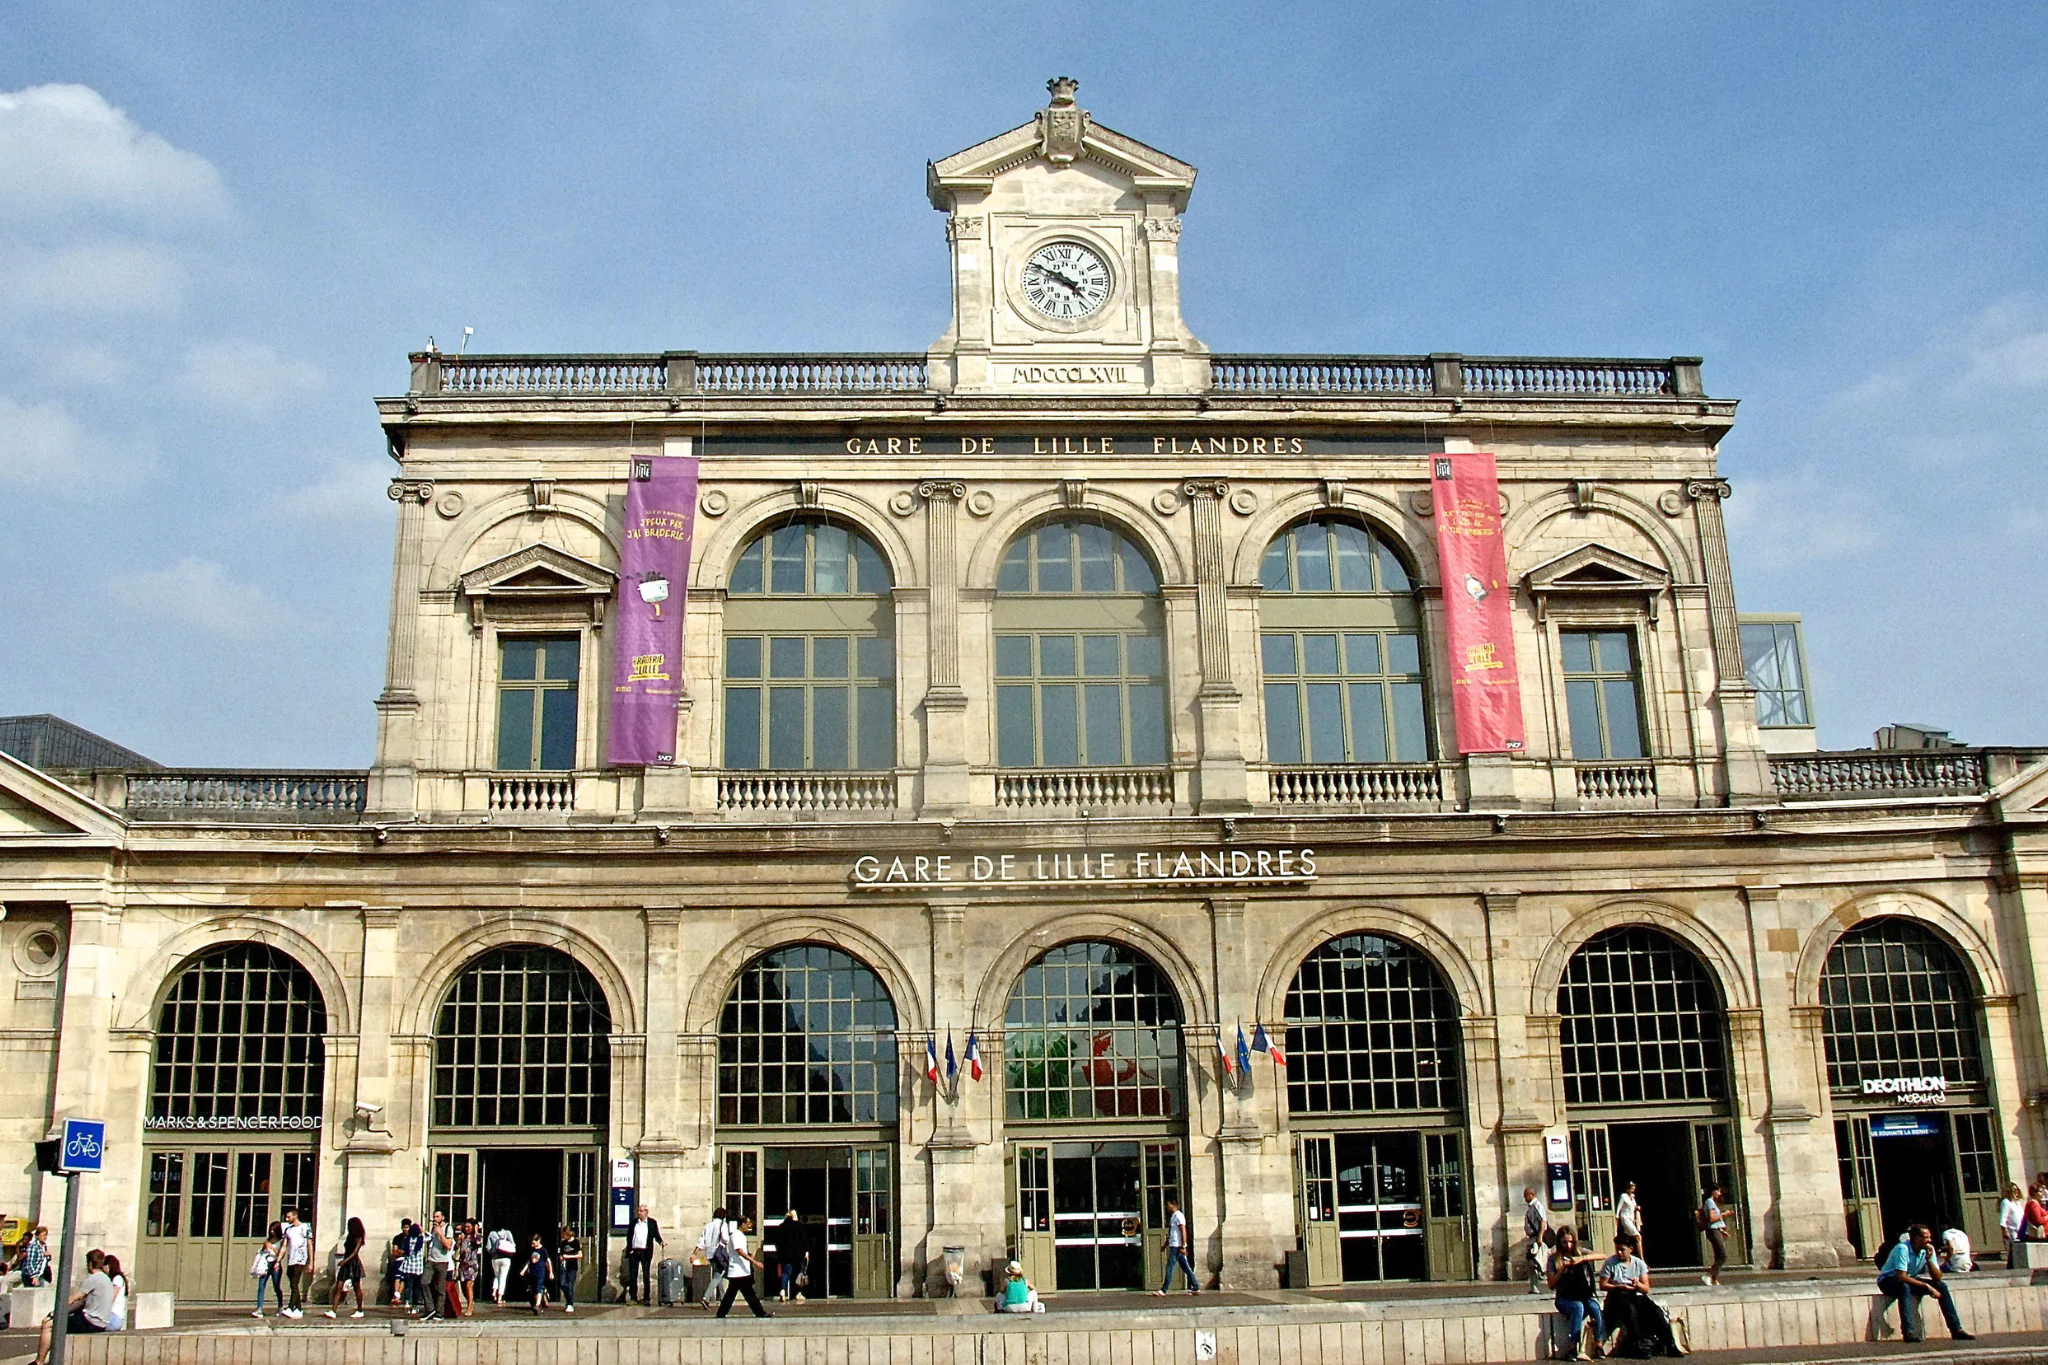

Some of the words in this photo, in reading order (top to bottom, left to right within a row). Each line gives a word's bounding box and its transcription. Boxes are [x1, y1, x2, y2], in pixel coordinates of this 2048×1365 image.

[1012, 367, 1128, 383] MDCCCLXVII
[846, 438, 922, 454] GARE
[961, 438, 995, 454] DE
[1034, 438, 1114, 454] LILLE
[1153, 437, 1304, 454] FLANDRES
[645, 528, 684, 540] BRADERIE
[855, 856, 952, 882] GARE
[974, 854, 1016, 880] DE
[1038, 853, 1116, 880] LILLE
[1136, 849, 1316, 878] FLANDRES
[1863, 1076, 1946, 1094] DECATHLON
[144, 1116, 194, 1129] MARKS
[208, 1116, 278, 1129] SPENCER
[281, 1116, 322, 1129] FOOD
